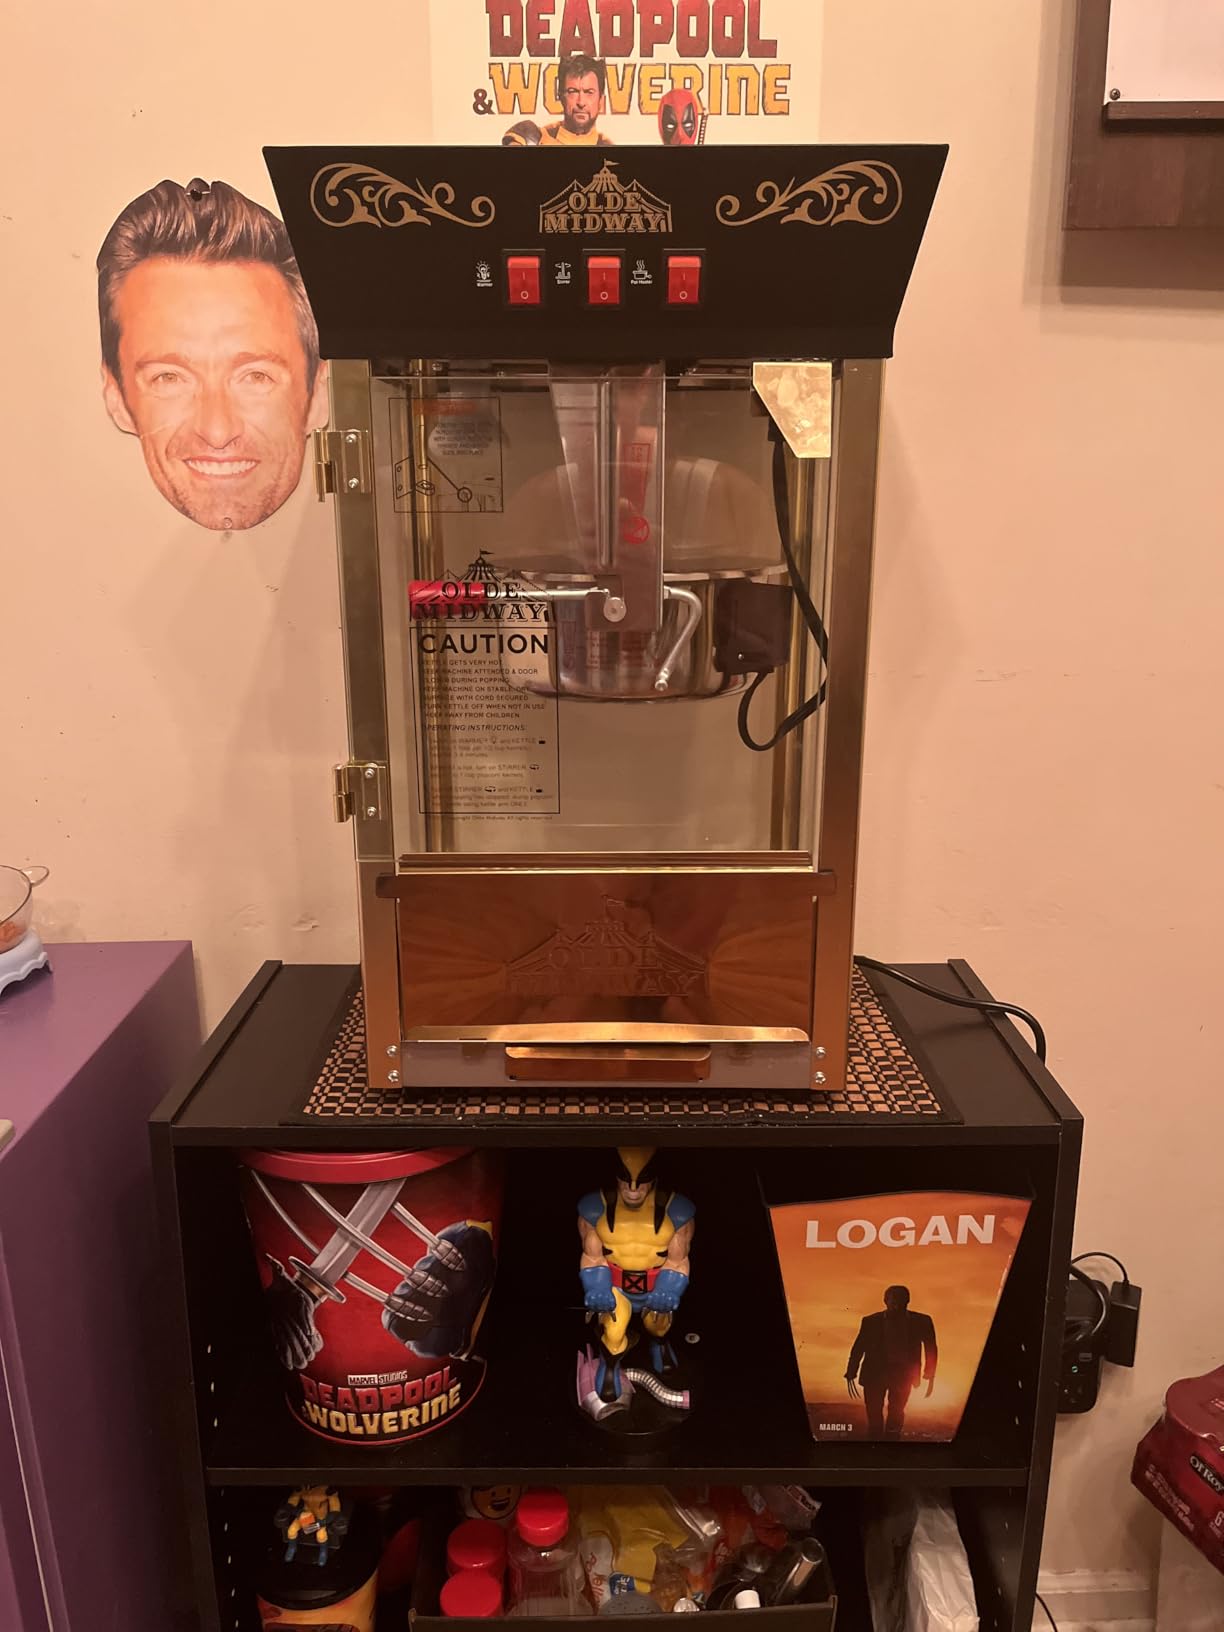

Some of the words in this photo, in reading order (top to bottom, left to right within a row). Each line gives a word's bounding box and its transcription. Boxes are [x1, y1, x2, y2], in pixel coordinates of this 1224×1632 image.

[485, 0, 778, 58] DEADPOOL
[488, 62, 792, 116] WVERINE
[568, 191, 642, 213] OLDE
[544, 213, 664, 234] MIDWAY
[441, 581, 521, 600] OLDE
[415, 603, 546, 622] MIDWAY
[420, 633, 548, 654] CAUTION
[805, 1214, 996, 1249] LOGAN
[299, 1366, 457, 1412] DEADPOOL
[348, 1374, 378, 1386] MARVEL
[304, 1383, 462, 1435] WOLVERINE
[819, 1423, 846, 1432] MARCH
[847, 1423, 853, 1432] 3
